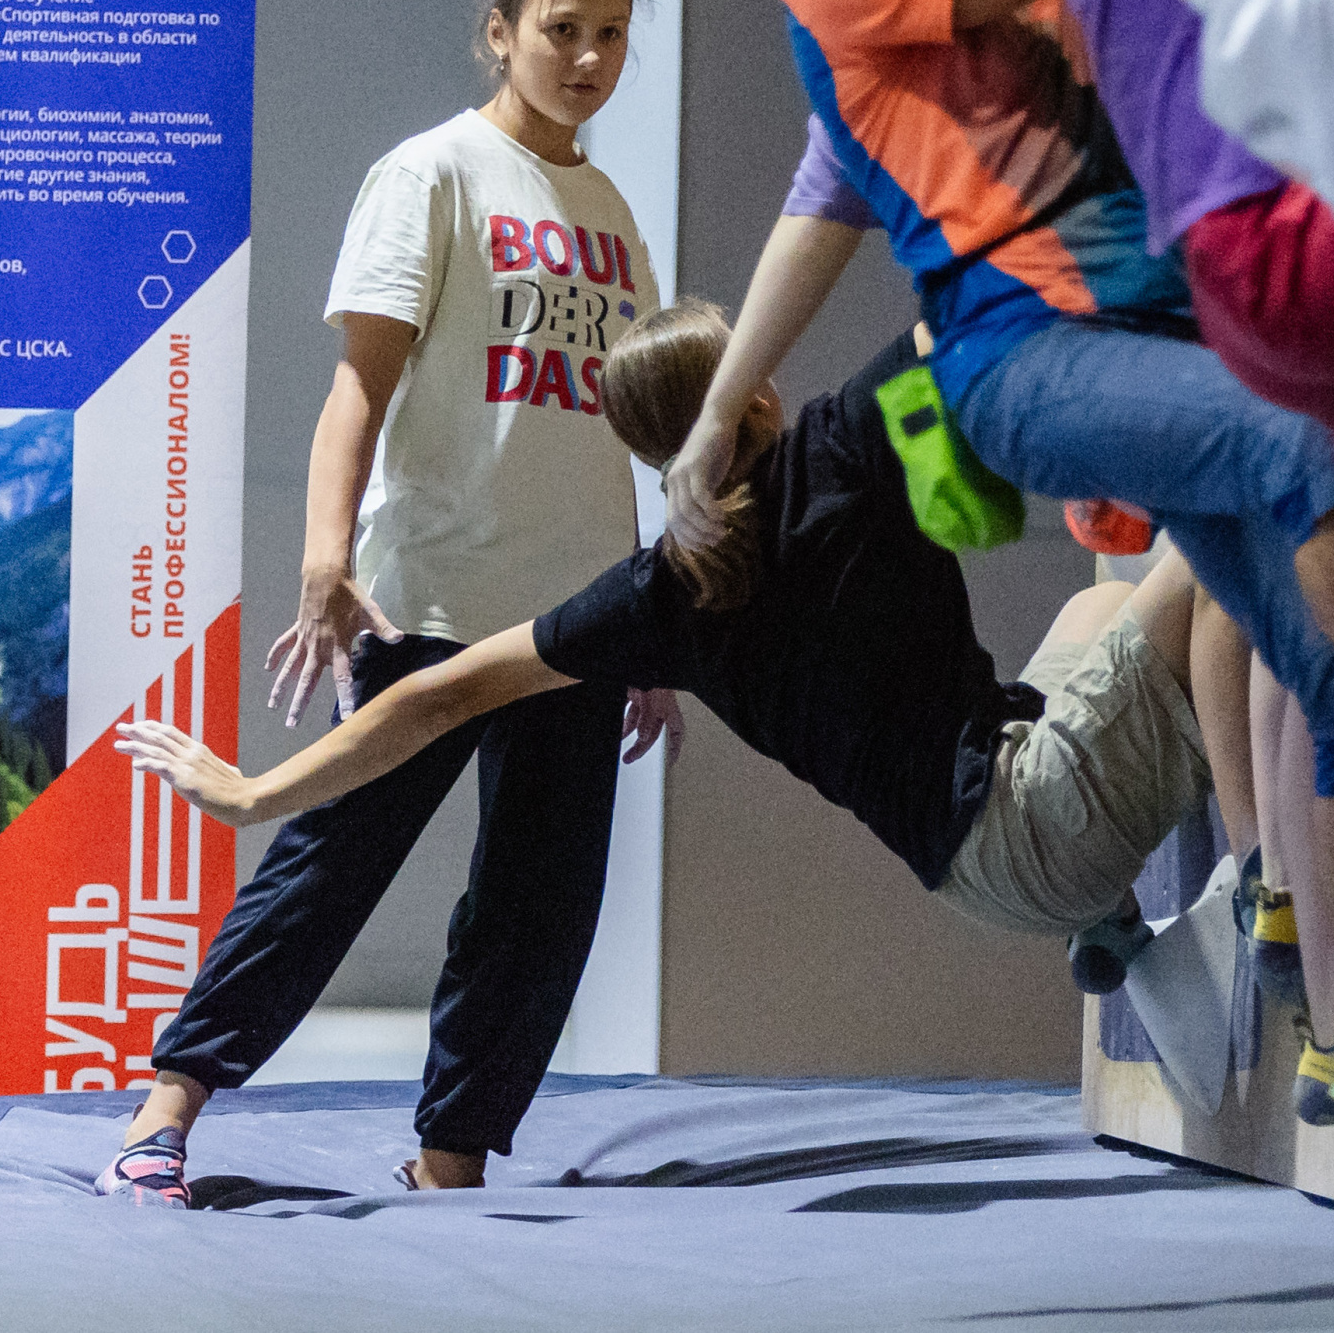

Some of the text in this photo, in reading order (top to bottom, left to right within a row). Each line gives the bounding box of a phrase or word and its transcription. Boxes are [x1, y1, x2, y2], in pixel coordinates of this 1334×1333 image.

[103, 11, 196, 26] подготовка
[199, 13, 220, 25] по
[2, 29, 115, 44] деятельность
[118, 31, 129, 43] в
[131, 28, 197, 45] области
[21, 47, 141, 65] квалификации
[37, 106, 125, 124] биохимии,
[129, 111, 213, 125] анатомии,
[87, 131, 160, 144] массажа,
[164, 132, 222, 147] теории
[97, 150, 176, 165] процесса,
[27, 169, 85, 185] другие
[88, 170, 150, 184] знания,
[28, 189, 50, 202] во
[52, 189, 104, 205] время
[107, 187, 189, 206] обучения.
[487, 280, 609, 351] DER
[16, 339, 72, 360] ЦСКА.
[163, 333, 191, 638] ПРОФЕССИОНАЛОМ!
[131, 545, 153, 638] СТАНЬ
